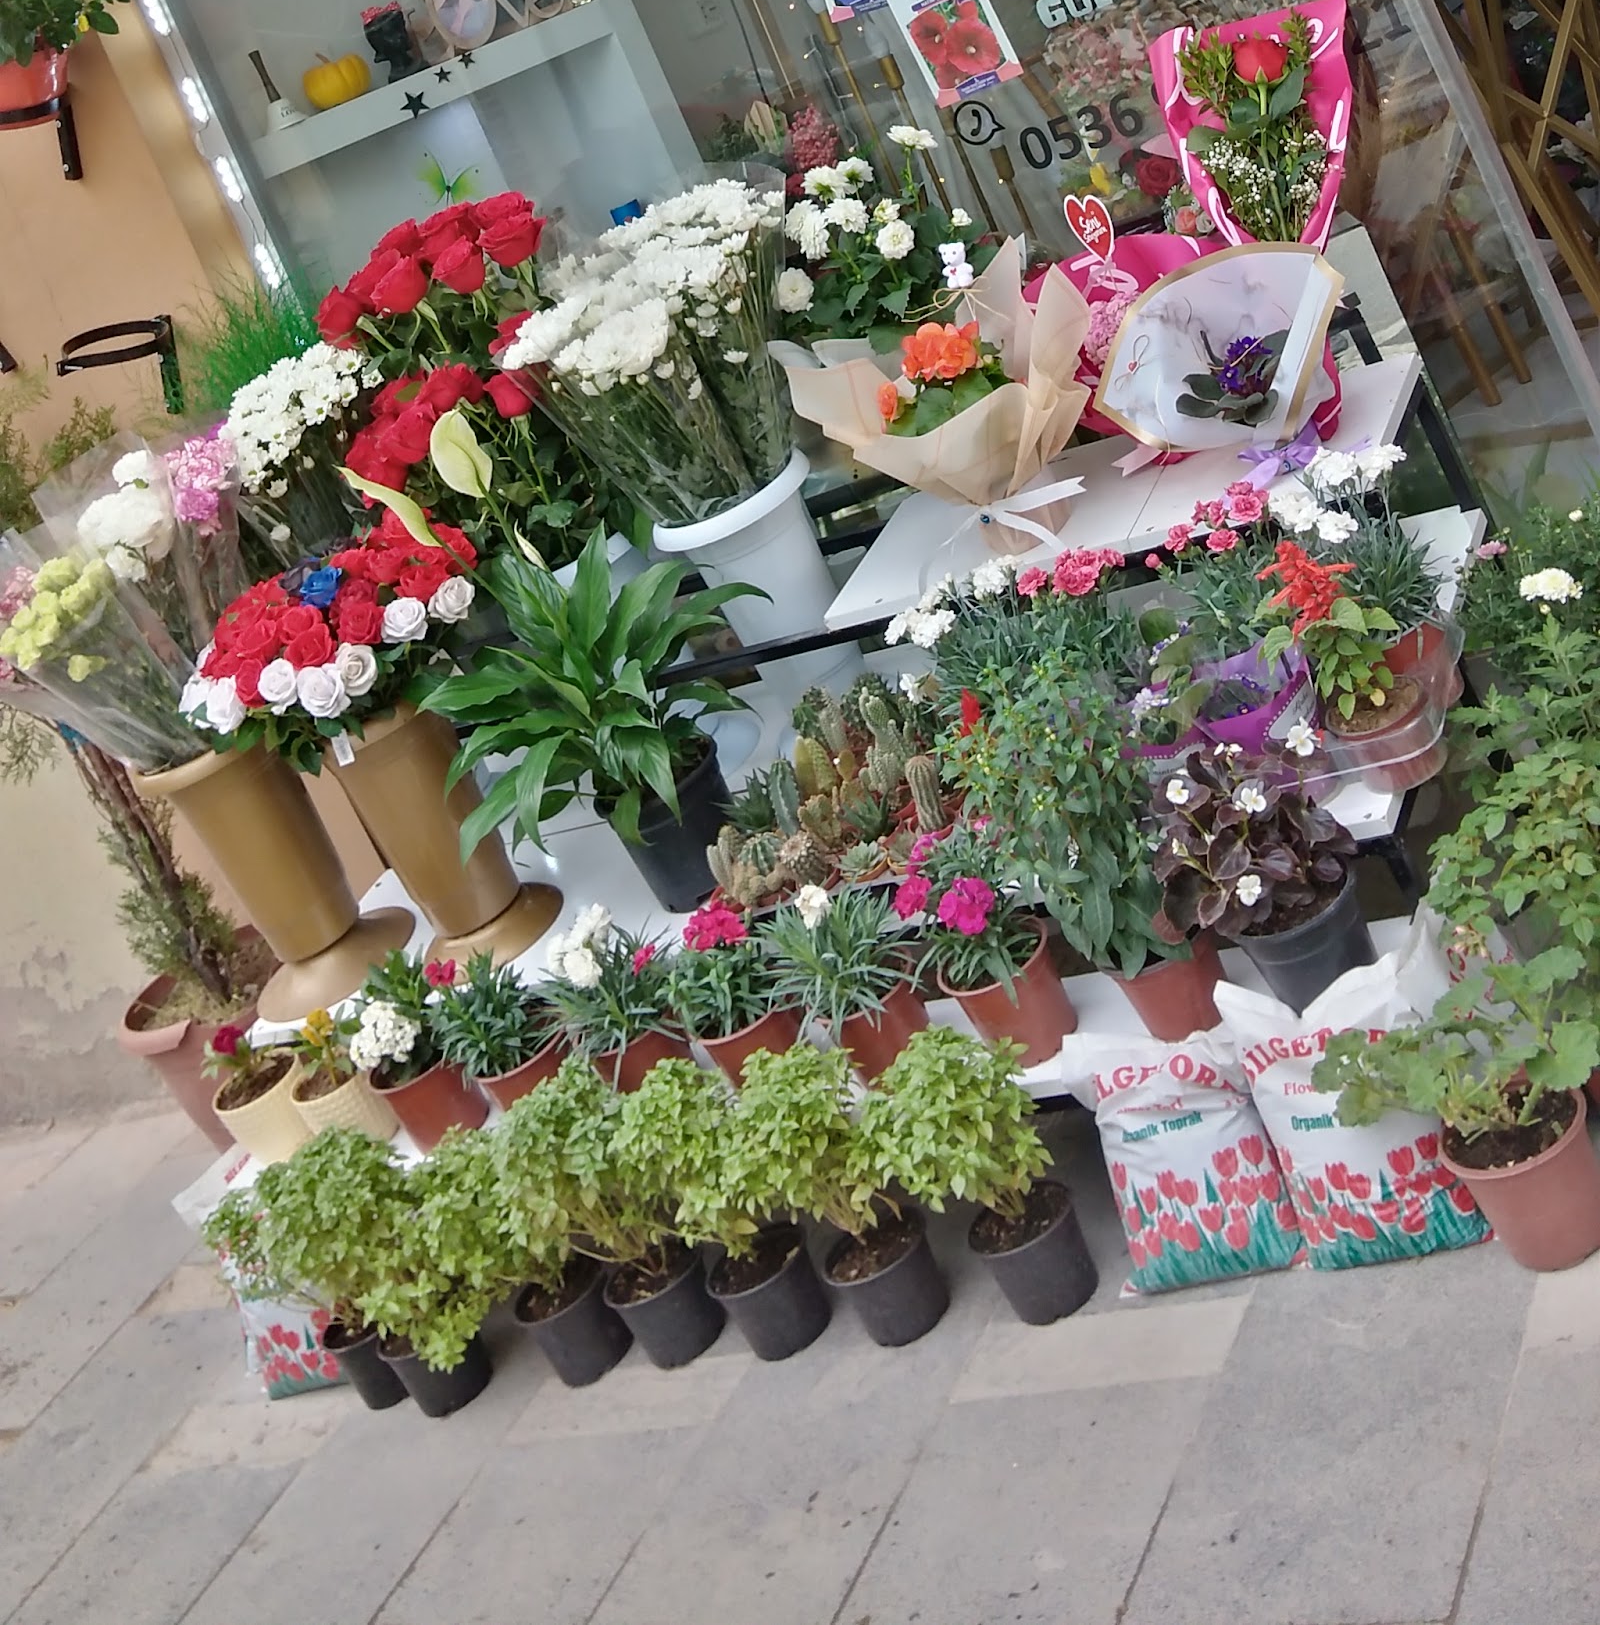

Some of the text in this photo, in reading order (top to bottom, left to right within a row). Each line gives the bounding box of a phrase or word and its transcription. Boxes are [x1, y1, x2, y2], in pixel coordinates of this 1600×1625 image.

[1019, 90, 1143, 170] 0536
[1078, 210, 1101, 234] Seni
[1284, 1081, 1318, 1097] Flow
[1161, 1110, 1203, 1133] Toprak
[1291, 1114, 1335, 1133] Organik
